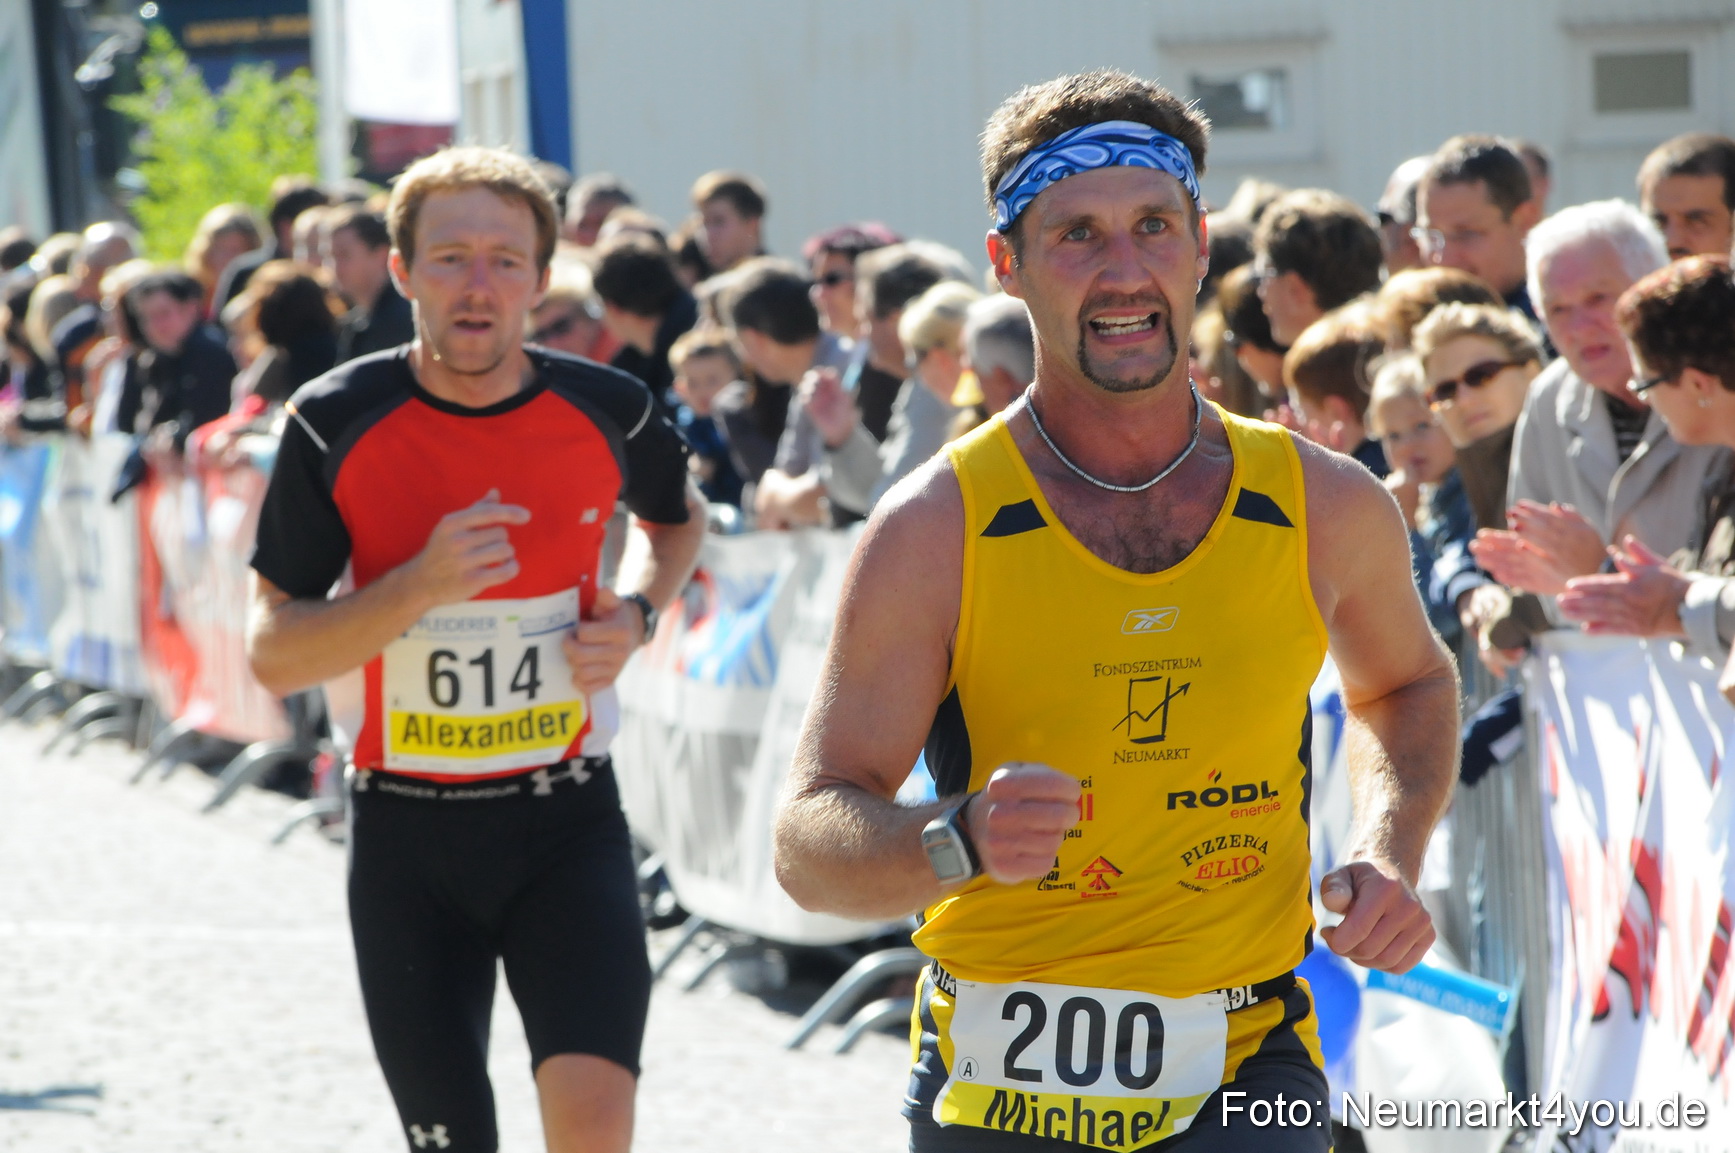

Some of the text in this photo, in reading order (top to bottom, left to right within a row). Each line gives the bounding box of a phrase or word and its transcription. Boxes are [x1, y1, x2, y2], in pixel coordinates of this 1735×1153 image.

[427, 646, 542, 708] 614
[402, 708, 571, 749] Alexander
[1230, 796, 1281, 819] energie
[1180, 834, 1269, 867] PIZZERIA
[1194, 854, 1260, 880] ELIO
[1001, 991, 1165, 1090] 200
[963, 1062, 972, 1078] A
[983, 1089, 1171, 1147] Michael
